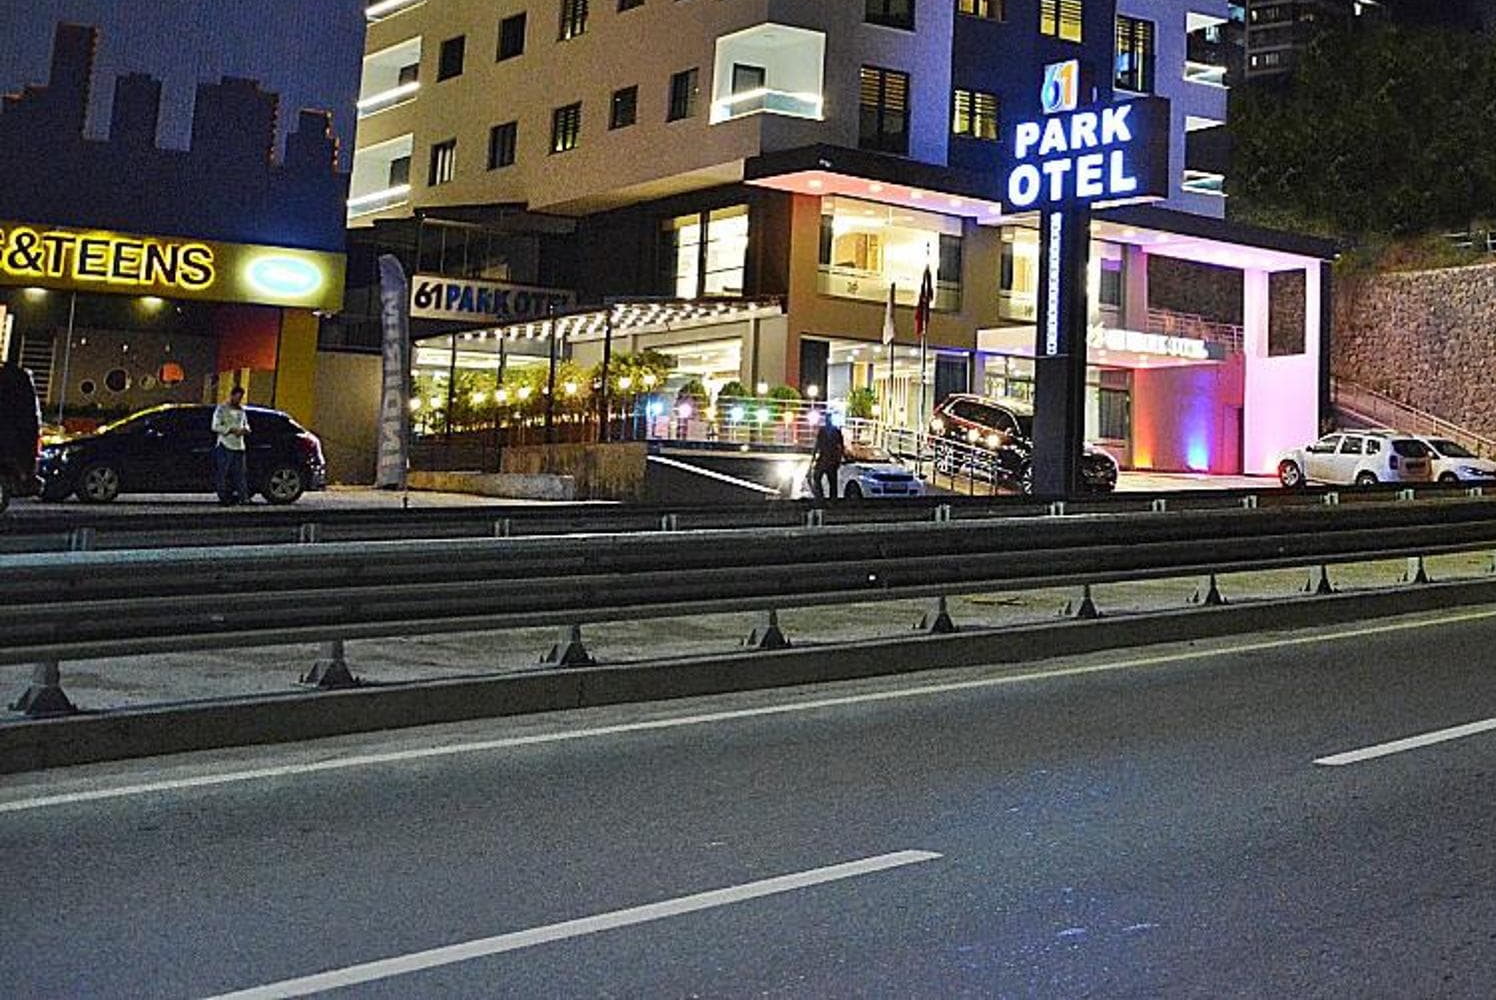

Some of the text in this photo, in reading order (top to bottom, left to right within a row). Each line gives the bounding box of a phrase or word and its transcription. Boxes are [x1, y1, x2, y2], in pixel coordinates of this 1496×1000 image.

[1041, 60, 1078, 114] 61
[1015, 104, 1132, 159] PARK
[1008, 150, 1136, 206] OTEL
[0, 231, 213, 286] &TEENS
[514, 291, 574, 319] OT
